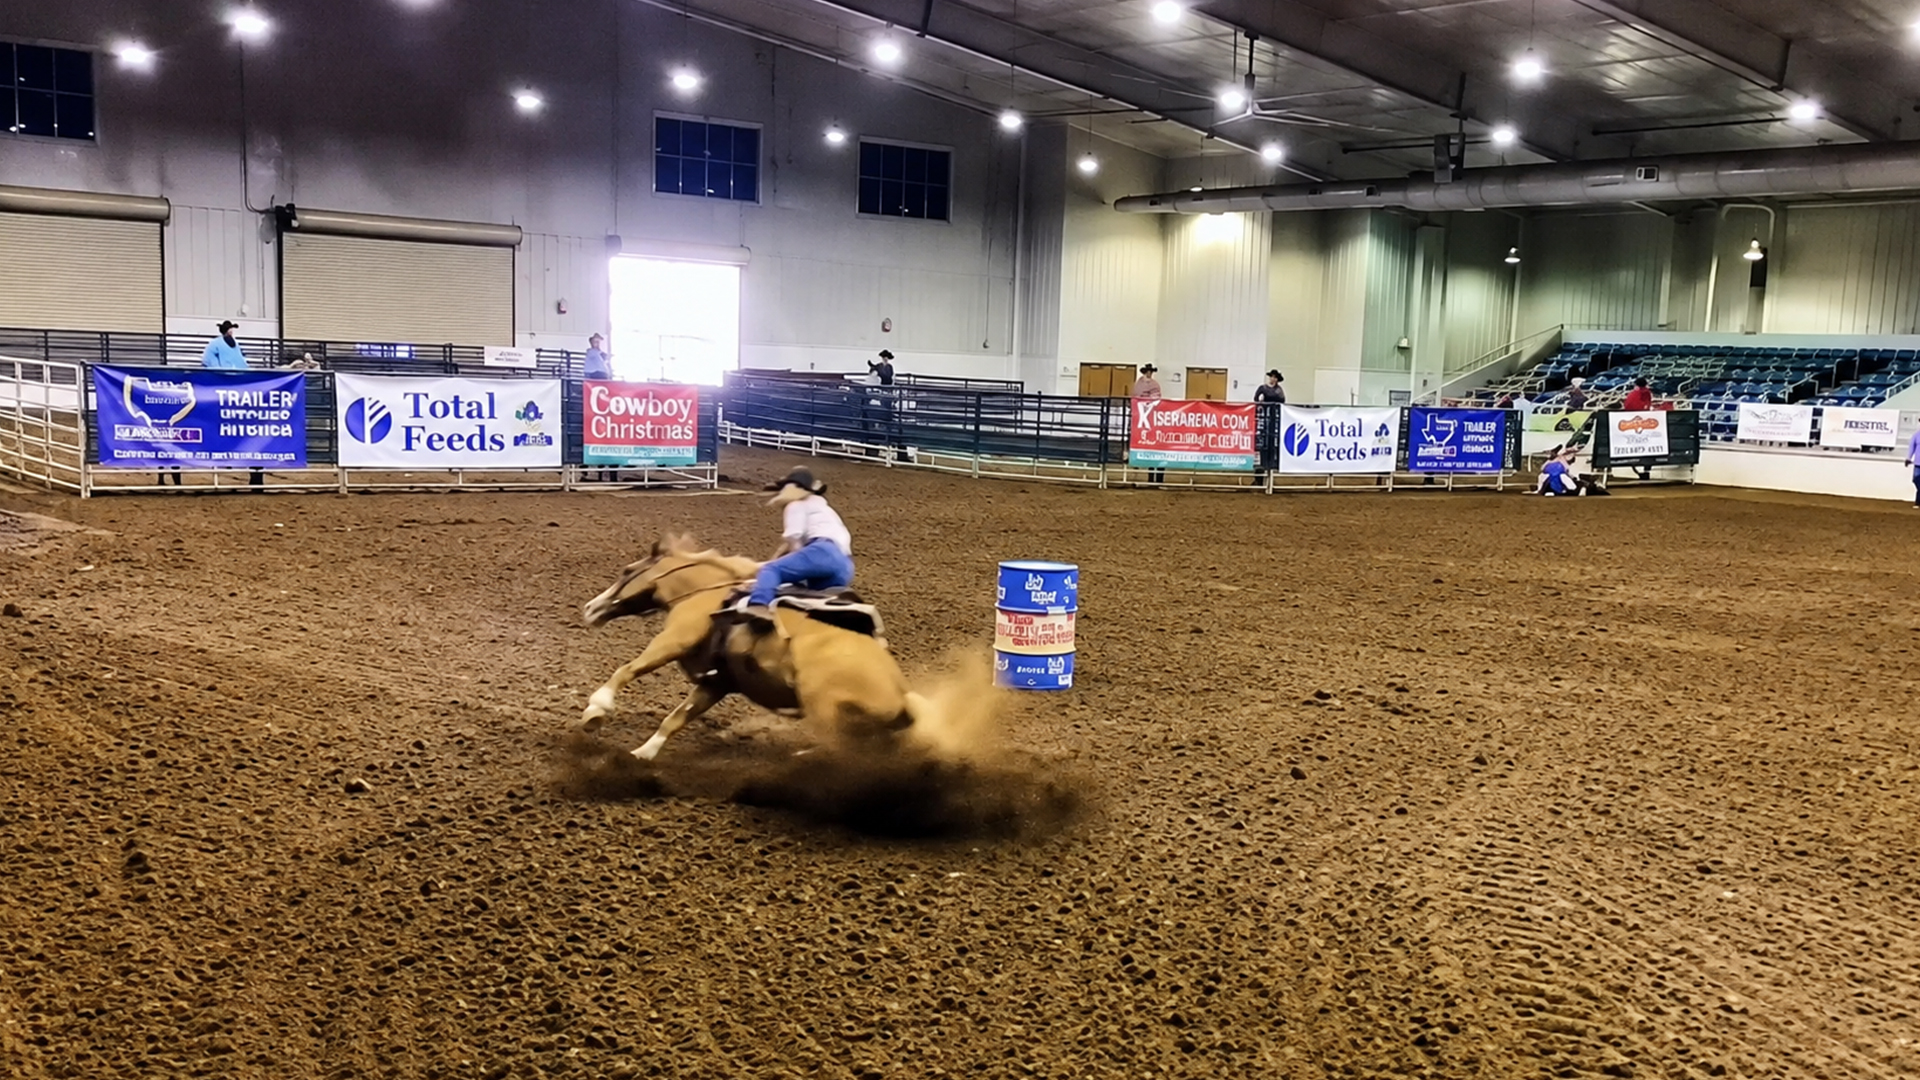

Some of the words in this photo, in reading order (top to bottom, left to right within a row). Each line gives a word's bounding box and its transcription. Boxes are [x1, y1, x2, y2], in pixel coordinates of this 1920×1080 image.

[215, 390, 293, 408] TRAILER
[403, 392, 498, 420] Total
[590, 386, 692, 423] Cowboy
[401, 424, 505, 452] Feeds
[591, 416, 694, 440] Christmas
[1315, 418, 1363, 438] Total
[1314, 442, 1367, 462] Feeds
